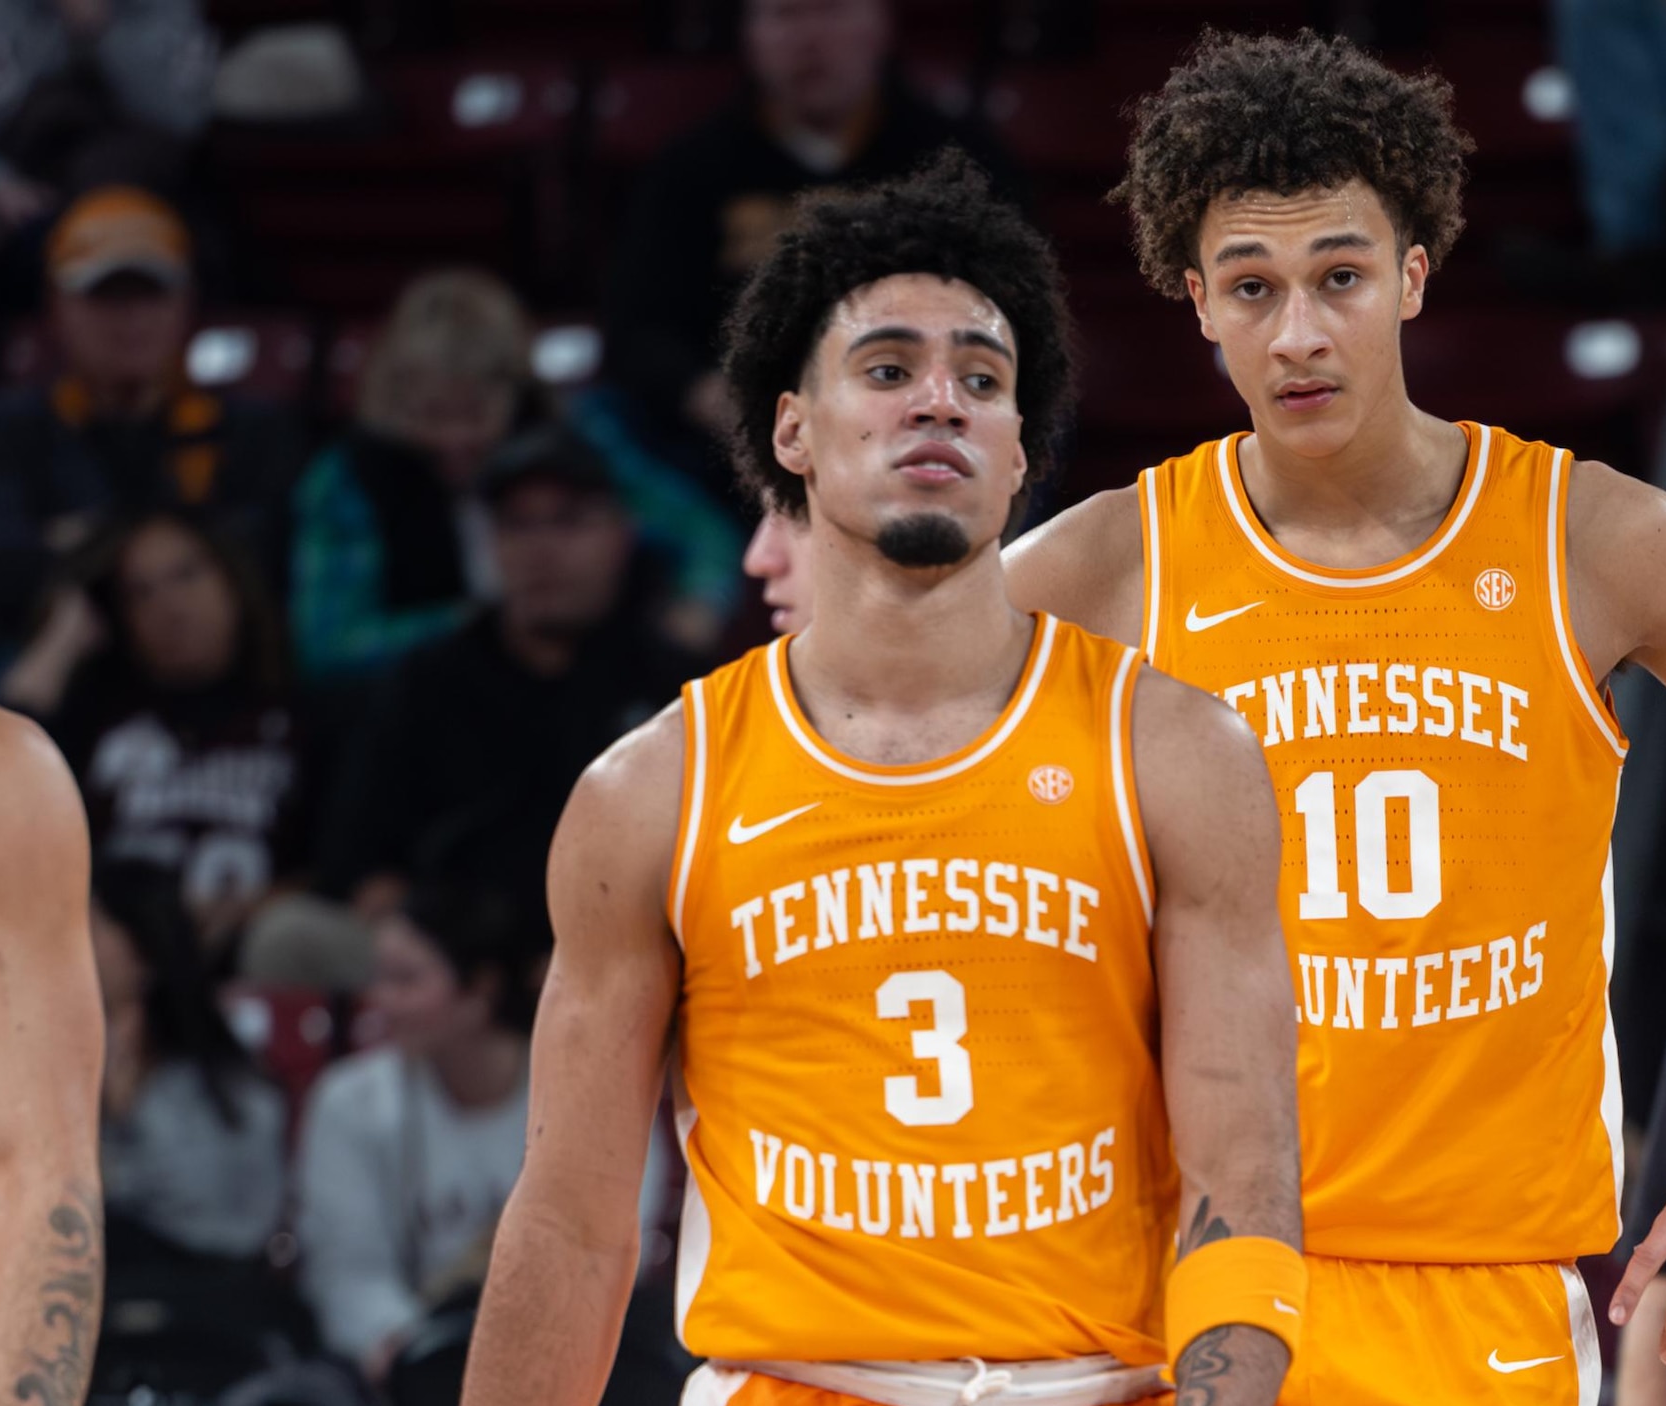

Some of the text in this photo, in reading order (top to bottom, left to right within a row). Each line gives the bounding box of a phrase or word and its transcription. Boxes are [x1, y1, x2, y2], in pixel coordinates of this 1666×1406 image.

[1477, 570, 1513, 608] SEC
[1213, 663, 1529, 761] NNESSEE
[1294, 769, 1442, 920] 10
[731, 858, 1099, 980] TENNESSEE
[1296, 920, 1548, 1030] UNTEERS
[875, 970, 974, 1126] 3
[749, 1126, 1116, 1239] VOLUNTEERS
